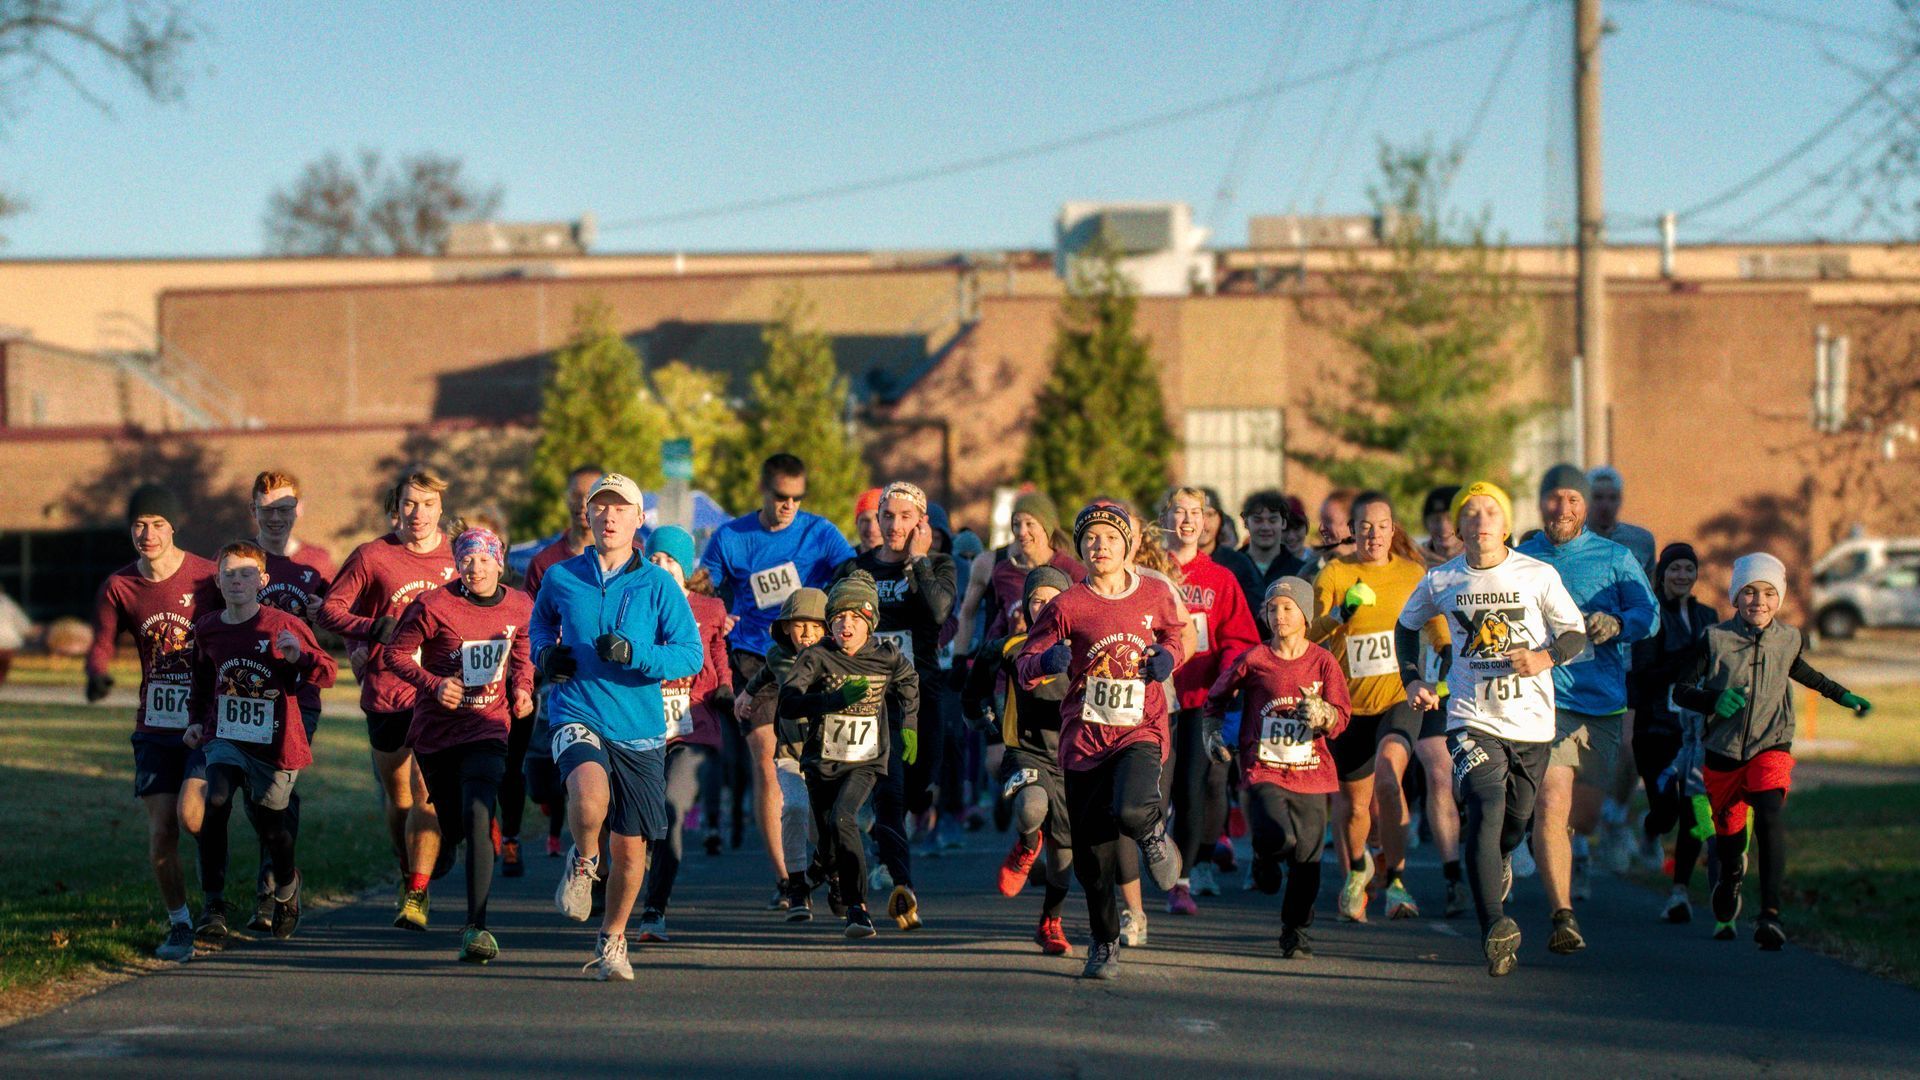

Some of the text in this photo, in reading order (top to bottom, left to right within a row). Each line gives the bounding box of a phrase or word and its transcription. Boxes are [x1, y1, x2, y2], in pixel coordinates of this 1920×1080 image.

[391, 580, 424, 603] BURNING
[757, 569, 792, 594] 694
[877, 580, 896, 589] EET
[1456, 592, 1520, 606] RIVERDALE
[140, 612, 195, 637] BURNING THIGHS
[470, 645, 503, 670] 684
[1086, 633, 1147, 660] BURNING THIGH
[1353, 635, 1391, 662] 729
[241, 659, 272, 678] THIGHS
[1469, 659, 1512, 670] CROSS COUN
[153, 688, 189, 713] 667
[462, 695, 484, 704] ATING
[1094, 681, 1134, 709] 681
[1482, 675, 1523, 701] 751
[226, 699, 265, 727] 685
[1260, 697, 1294, 716] BURNING
[555, 726, 592, 754] 732
[833, 719, 871, 745] 717
[1270, 721, 1307, 746] 682
